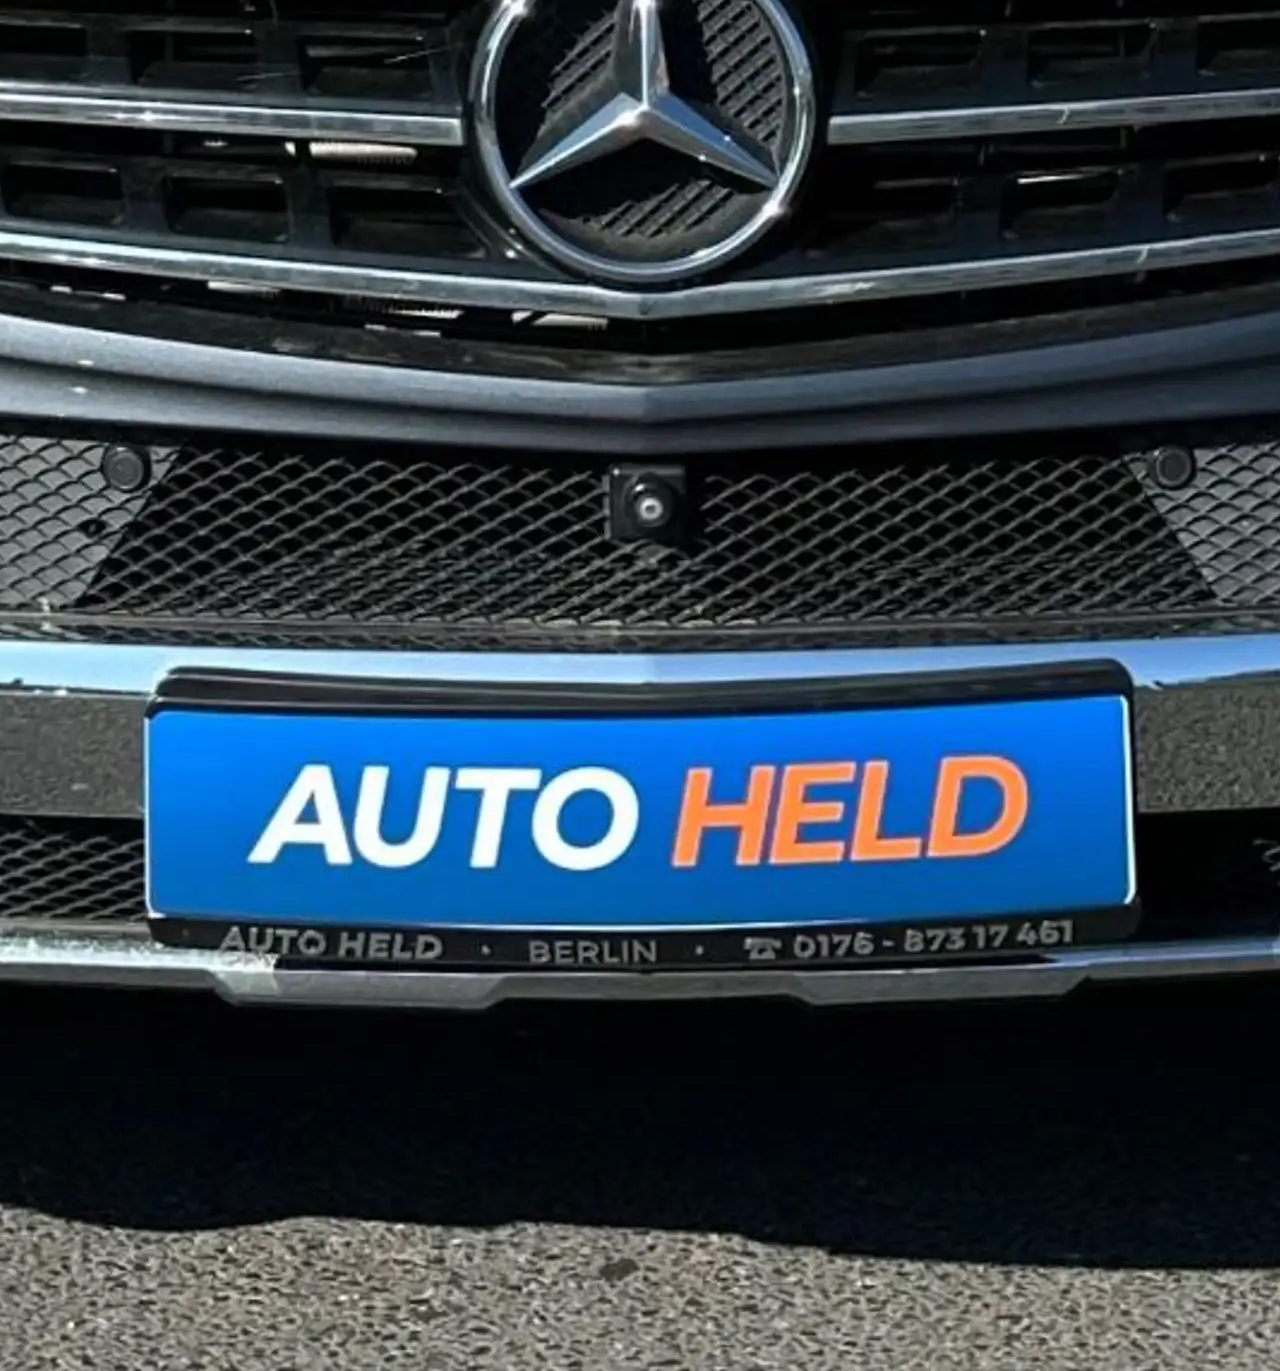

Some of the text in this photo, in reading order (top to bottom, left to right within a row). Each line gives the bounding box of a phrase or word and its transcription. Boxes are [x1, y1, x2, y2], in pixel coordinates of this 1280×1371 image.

[247, 754, 1028, 871] AUTO HELD
[220, 925, 327, 955] AUTO
[337, 931, 444, 960] HELD
[528, 939, 657, 966] BERLIN
[792, 931, 875, 960] 0176
[903, 927, 966, 953] 873
[972, 924, 1010, 949] 17
[1016, 919, 1074, 946] 461
